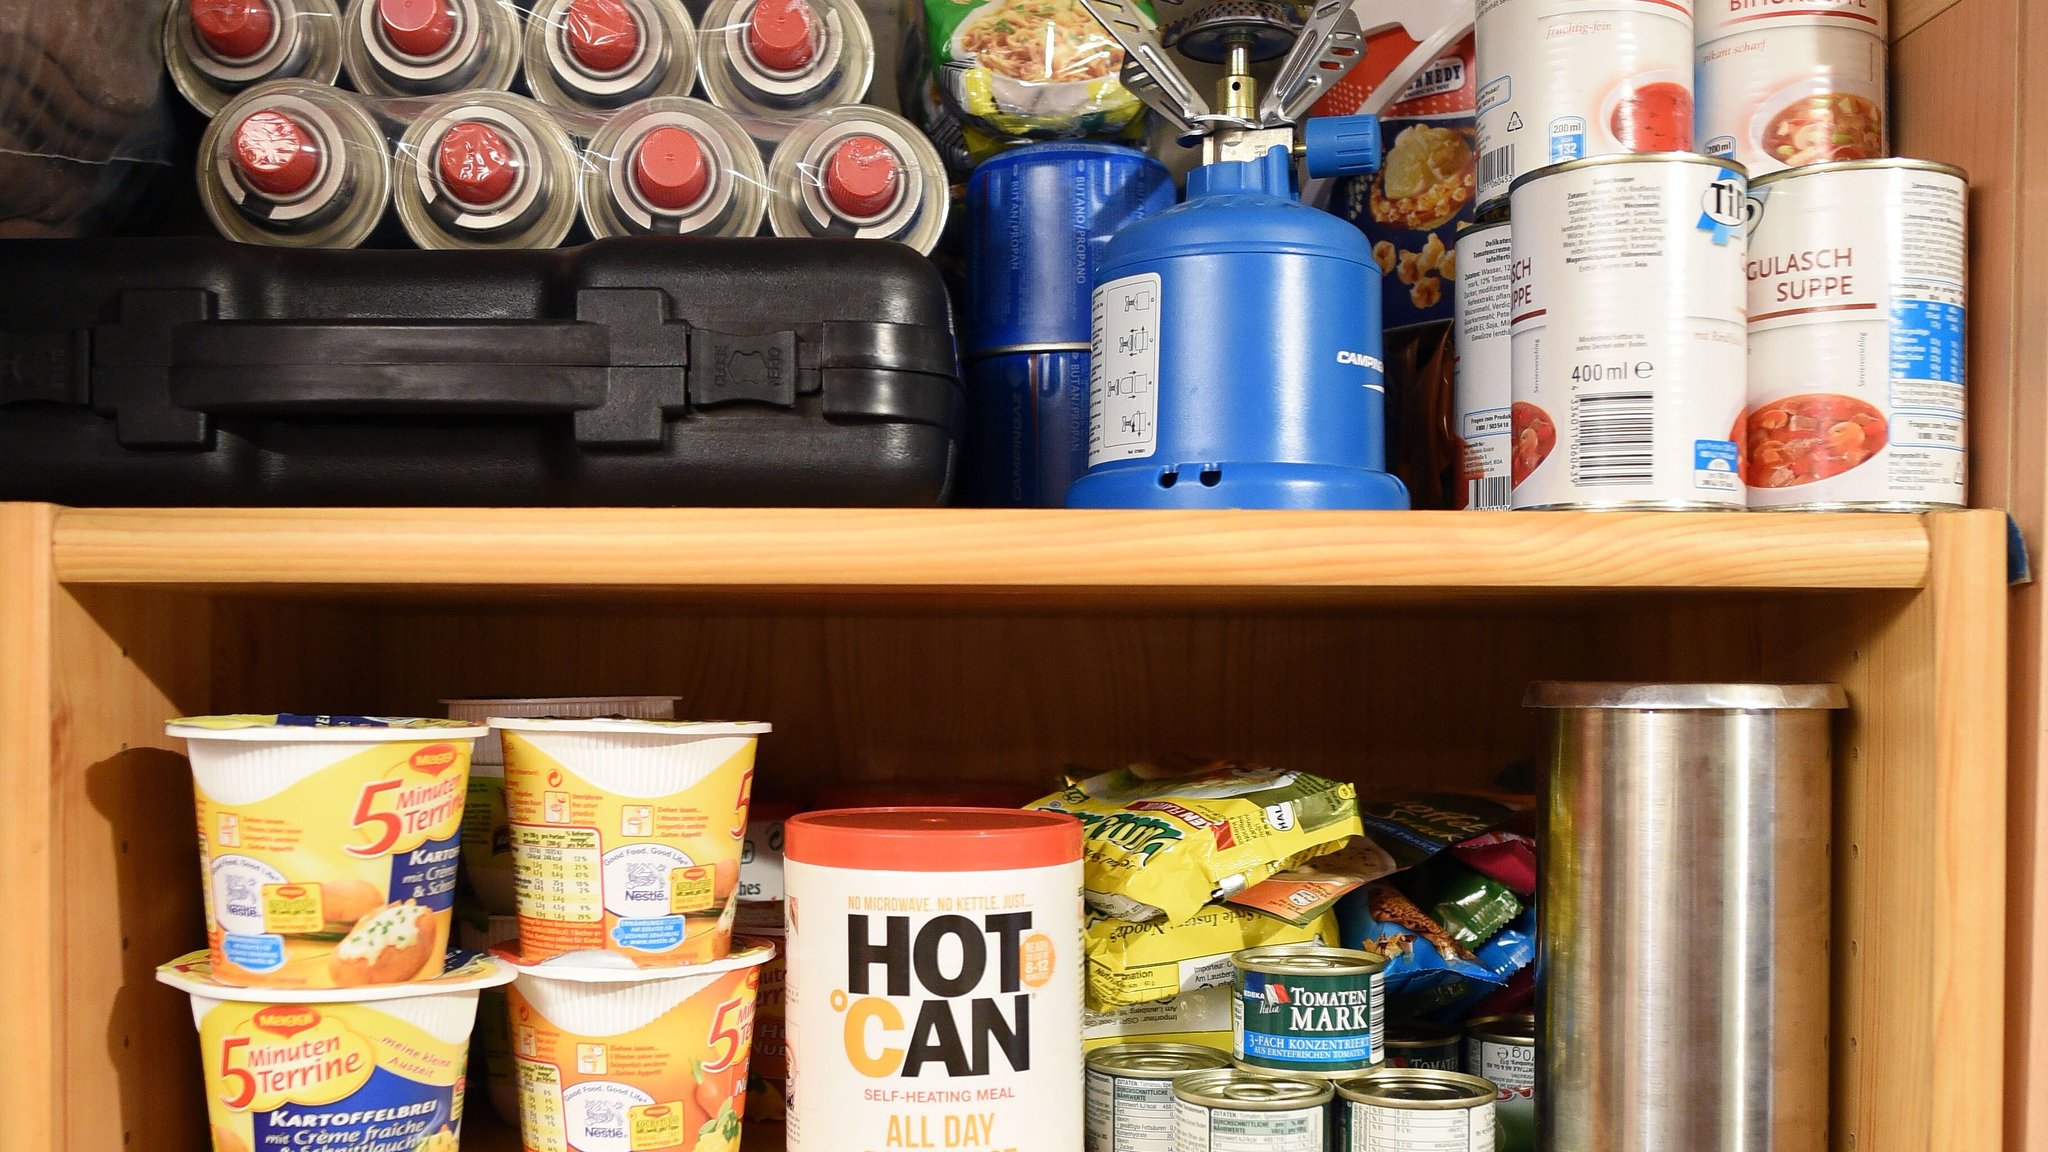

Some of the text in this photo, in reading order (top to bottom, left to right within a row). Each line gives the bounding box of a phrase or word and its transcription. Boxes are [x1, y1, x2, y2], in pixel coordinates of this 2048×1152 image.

[1073, 175, 1086, 284] BUTANO/PROPANO
[1486, 254, 1511, 264] tafelferti
[1746, 248, 1852, 281] GULASCH
[1776, 276, 1853, 302] SUPPE
[1572, 363, 1602, 382] 400
[1607, 361, 1627, 380] ml
[346, 779, 404, 856] 5
[404, 791, 465, 834] Terrin
[650, 848, 672, 858] Good
[739, 881, 761, 895] hes
[848, 896, 861, 910] NO
[864, 896, 934, 912] MICROWAVE.
[937, 896, 953, 911] NO
[957, 896, 1000, 911] KETTLE.
[848, 911, 1033, 998] HOT
[1243, 990, 1265, 1000] EDEKA
[1290, 987, 1367, 1007] TOMATEN
[259, 1012, 313, 1027] Maggi
[1288, 1005, 1368, 1031] MARK
[702, 997, 742, 1070] 5
[1249, 1035, 1285, 1048] 3-FACH
[1254, 1046, 1366, 1059] AUS ERNTEFRISCHEN TOMATEN
[220, 1036, 341, 1108] 5 Minuten
[255, 1051, 367, 1094] Terrine
[387, 1056, 435, 1079] Auszeit
[864, 1087, 1015, 1103] SELF-HEATING MEAL
[269, 1099, 438, 1127] KARTOFFELBREI
[265, 1119, 426, 1146] mit Crème fraîche
[886, 1113, 995, 1148] ALL DAY
